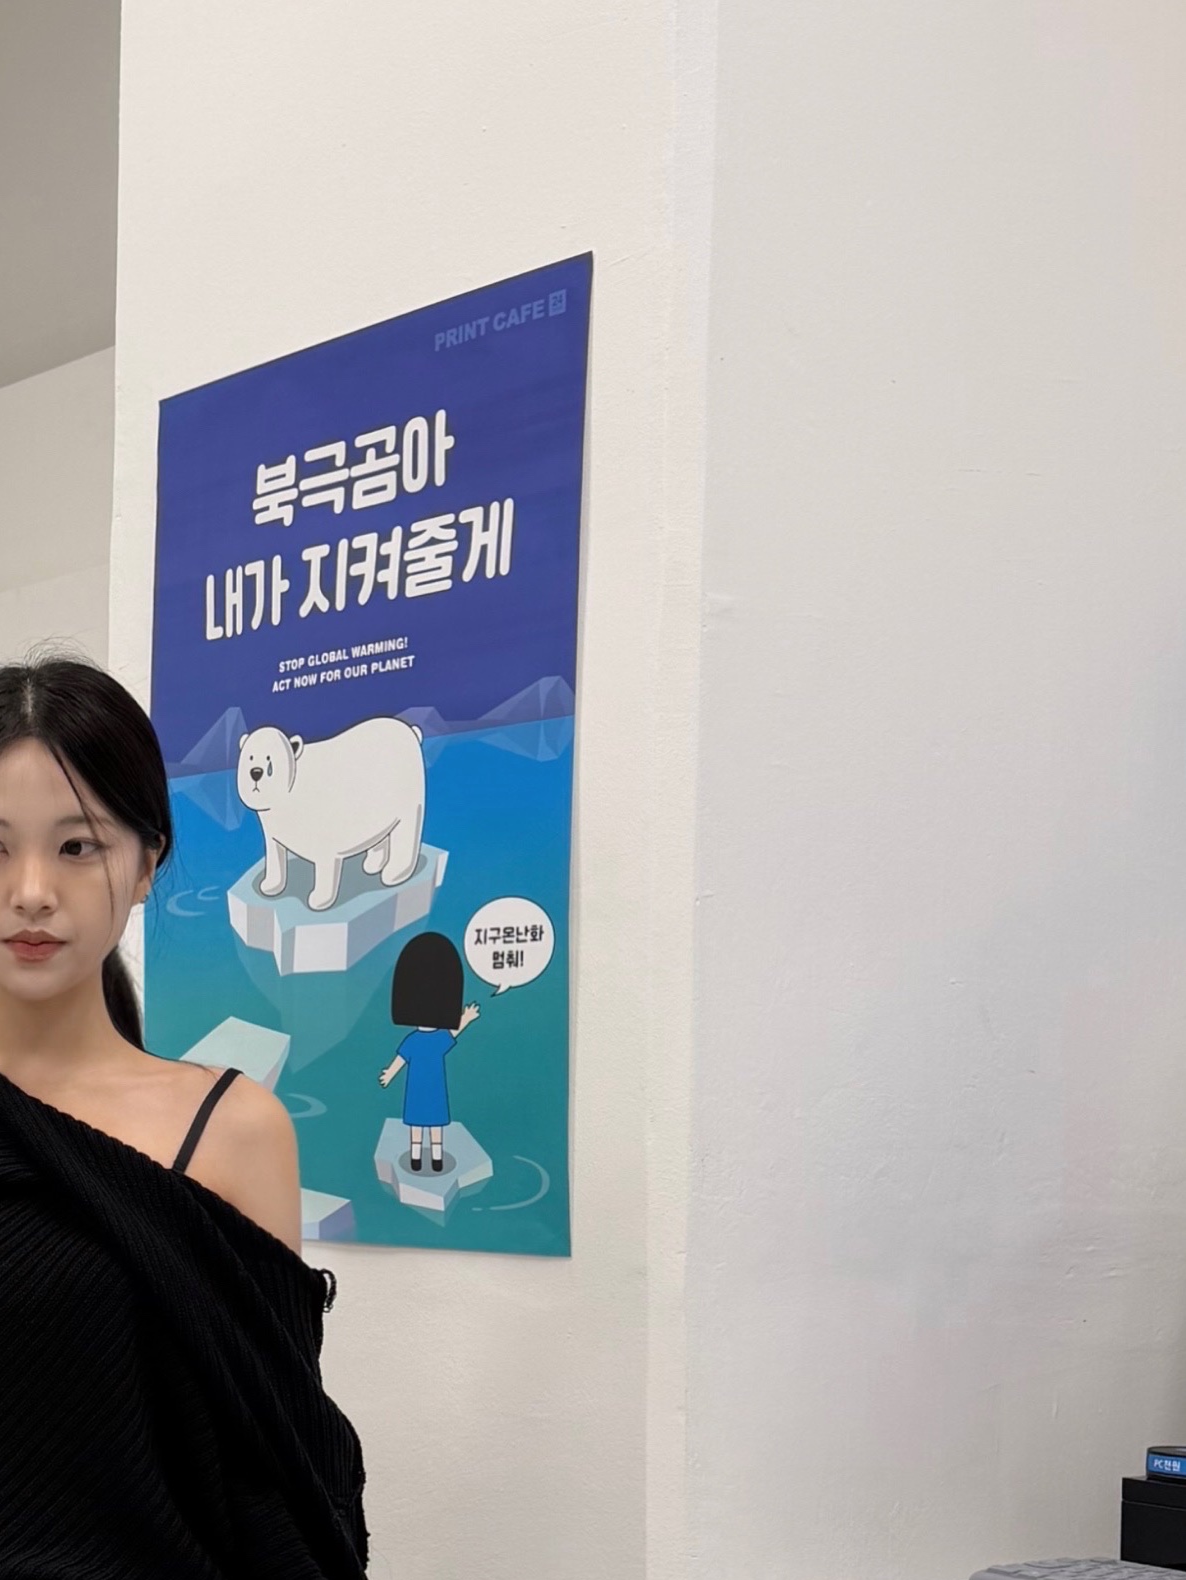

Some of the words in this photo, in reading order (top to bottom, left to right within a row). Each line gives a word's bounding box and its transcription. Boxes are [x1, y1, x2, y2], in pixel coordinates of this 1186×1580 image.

[434, 316, 490, 352] PRINT
[493, 299, 545, 331] CAFE
[252, 408, 455, 527] 북극곰아
[206, 554, 290, 640] 내가
[298, 497, 514, 618] 지켜줄게
[279, 657, 305, 673] STOP
[307, 648, 349, 667] GLOBAL
[351, 636, 408, 659] WARMING!
[272, 678, 291, 693] ACT
[294, 673, 317, 688] NOW
[320, 669, 341, 683] FOR
[343, 664, 368, 679] OUR
[371, 655, 415, 674] PLANET
[474, 924, 544, 946] 지구온난화
[492, 949, 524, 970] 멈춰!
